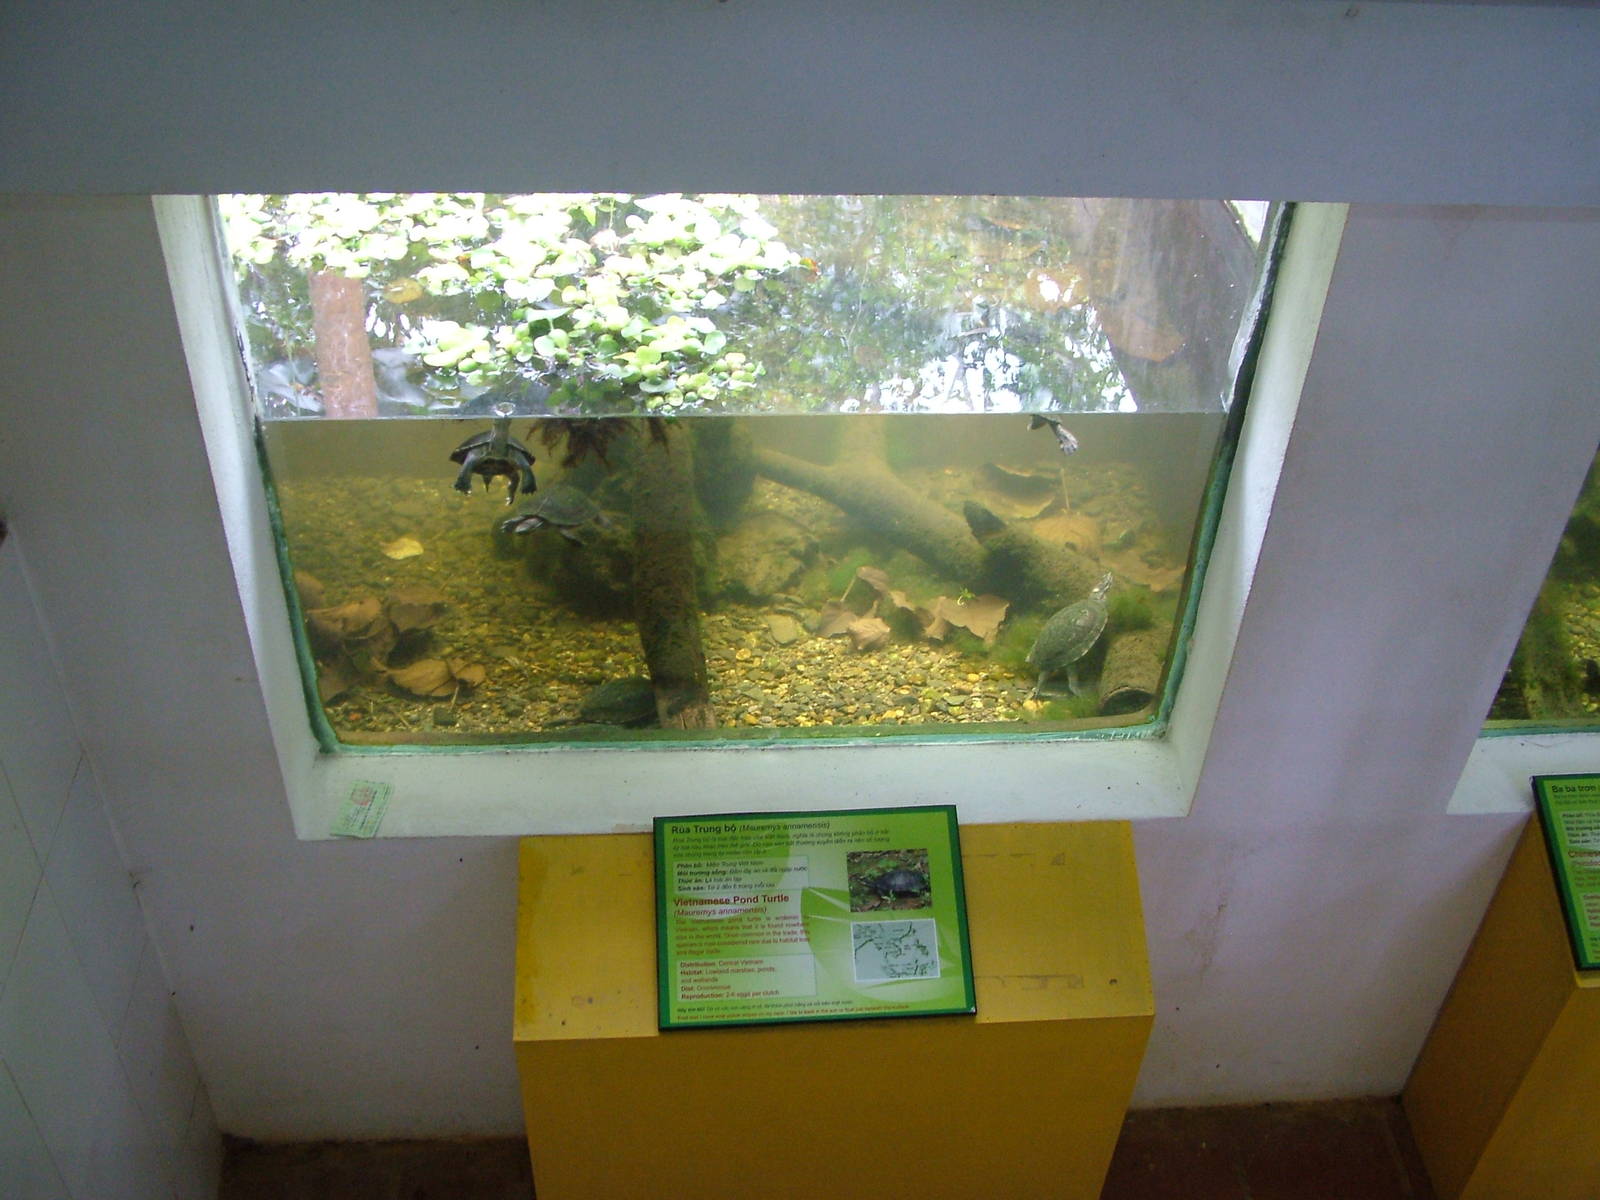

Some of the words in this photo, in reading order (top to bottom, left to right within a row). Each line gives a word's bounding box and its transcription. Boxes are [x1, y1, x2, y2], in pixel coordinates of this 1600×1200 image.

[1552, 784, 1563, 792] Ba
[1565, 784, 1576, 792] ba
[694, 824, 722, 834] Trung
[739, 823, 780, 833] (Mauremys
[674, 896, 730, 906] Vietnamese
[733, 896, 758, 904] Pond
[762, 894, 790, 903] Turtle
[674, 908, 716, 917] (Mauremys
